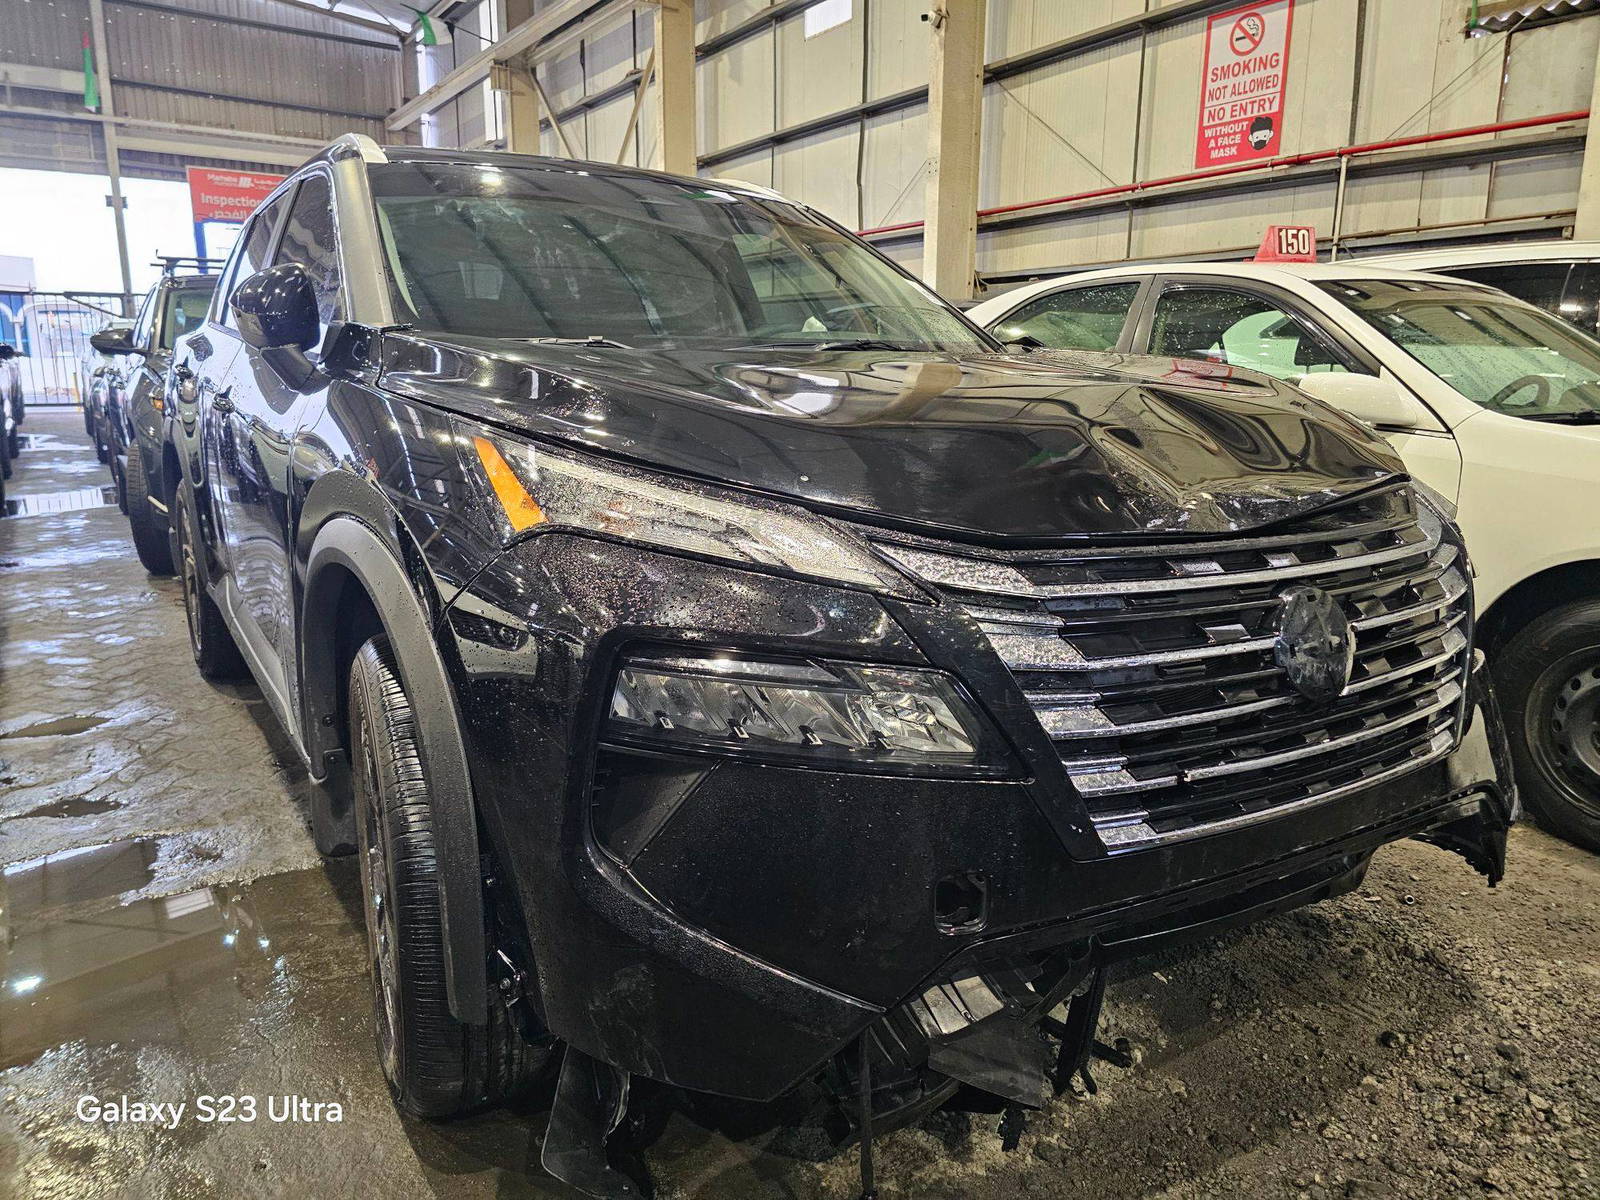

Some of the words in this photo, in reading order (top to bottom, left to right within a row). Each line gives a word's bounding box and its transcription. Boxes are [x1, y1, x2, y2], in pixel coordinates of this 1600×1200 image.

[1210, 52, 1280, 83] SMOKING
[1207, 85, 1228, 103] NOT
[1230, 73, 1279, 98] ALLOWED
[1207, 106, 1226, 123] NO
[1230, 95, 1276, 119] ENTRY
[1204, 121, 1249, 138] WITHOUT
[1208, 138, 1216, 149] A
[1217, 133, 1241, 147] FACE
[1210, 146, 1238, 159] MASK
[1279, 228, 1310, 254] 150
